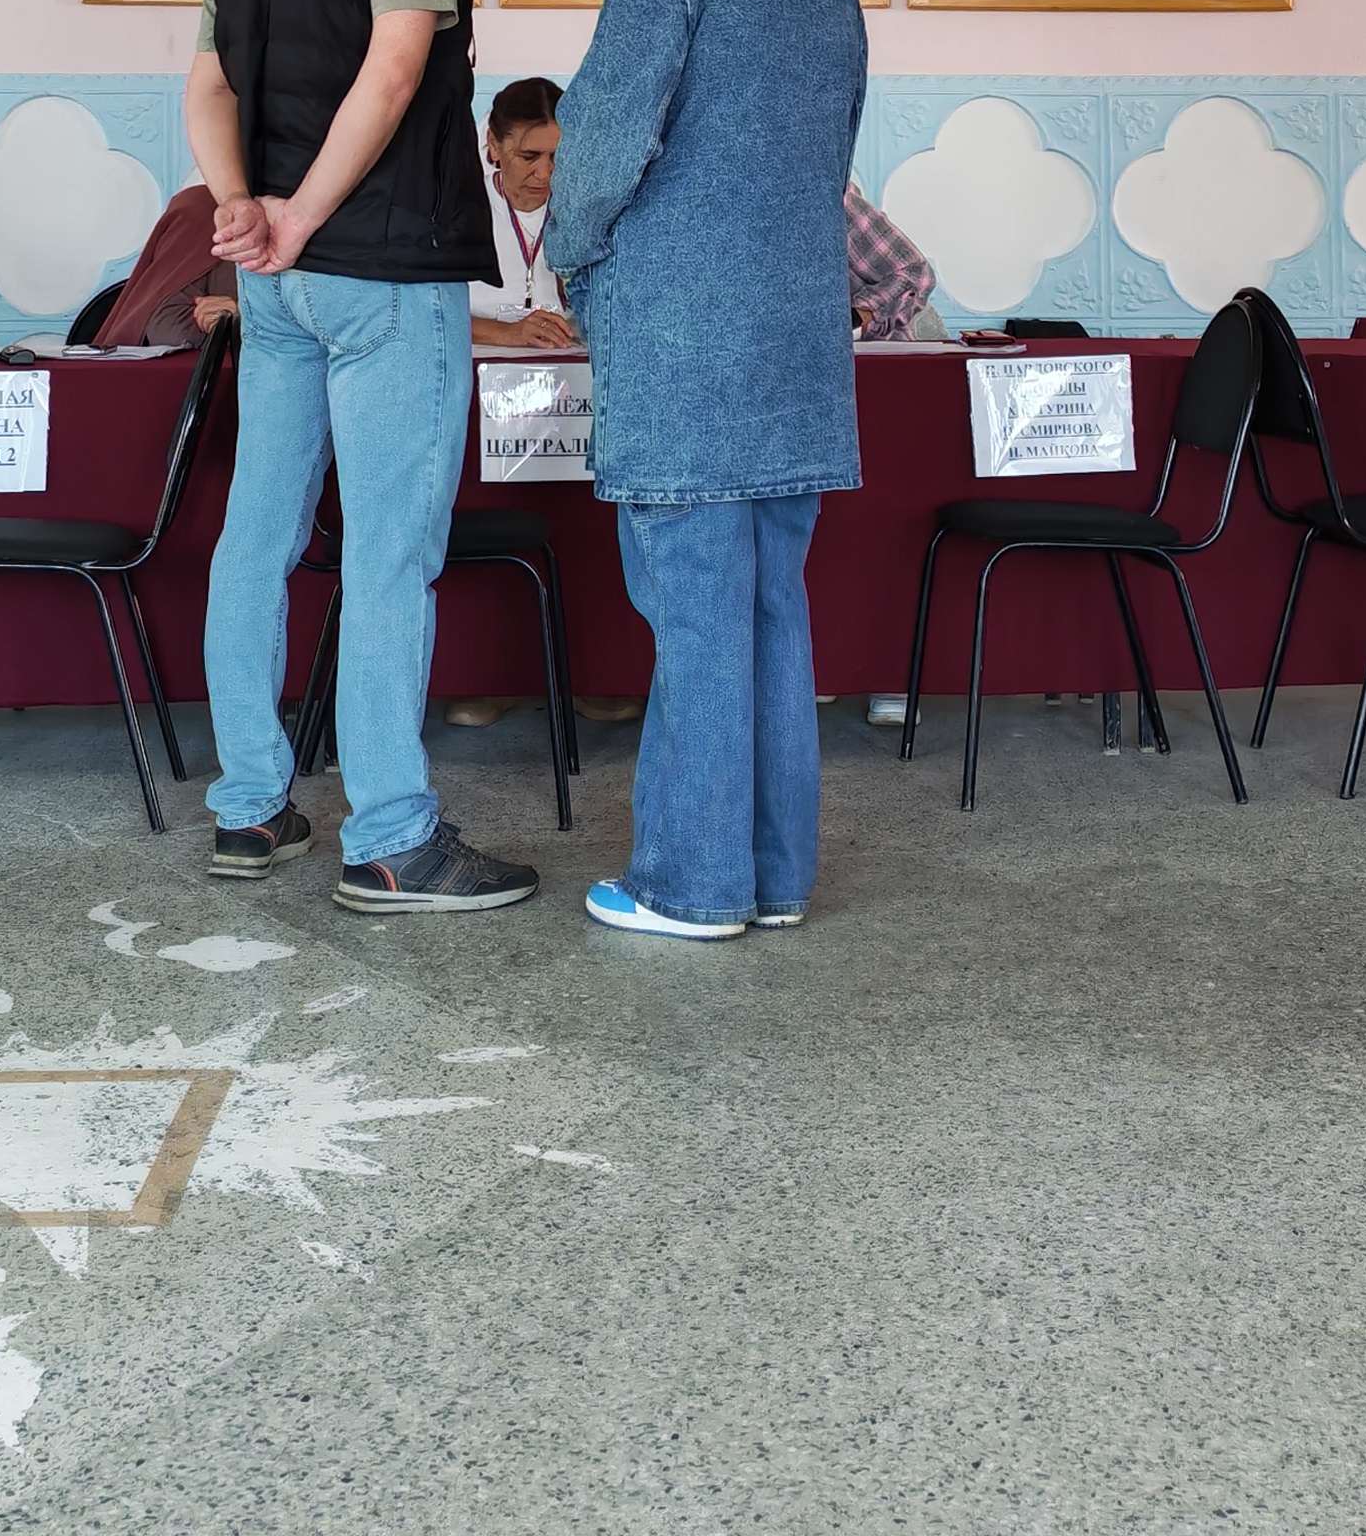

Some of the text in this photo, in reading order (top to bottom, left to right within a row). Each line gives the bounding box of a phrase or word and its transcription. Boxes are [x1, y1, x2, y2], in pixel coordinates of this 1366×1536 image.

[1020, 423, 1102, 437] СМИРНОВА
[6, 447, 17, 463] 2
[1026, 442, 1099, 458] МАЙКОВА
